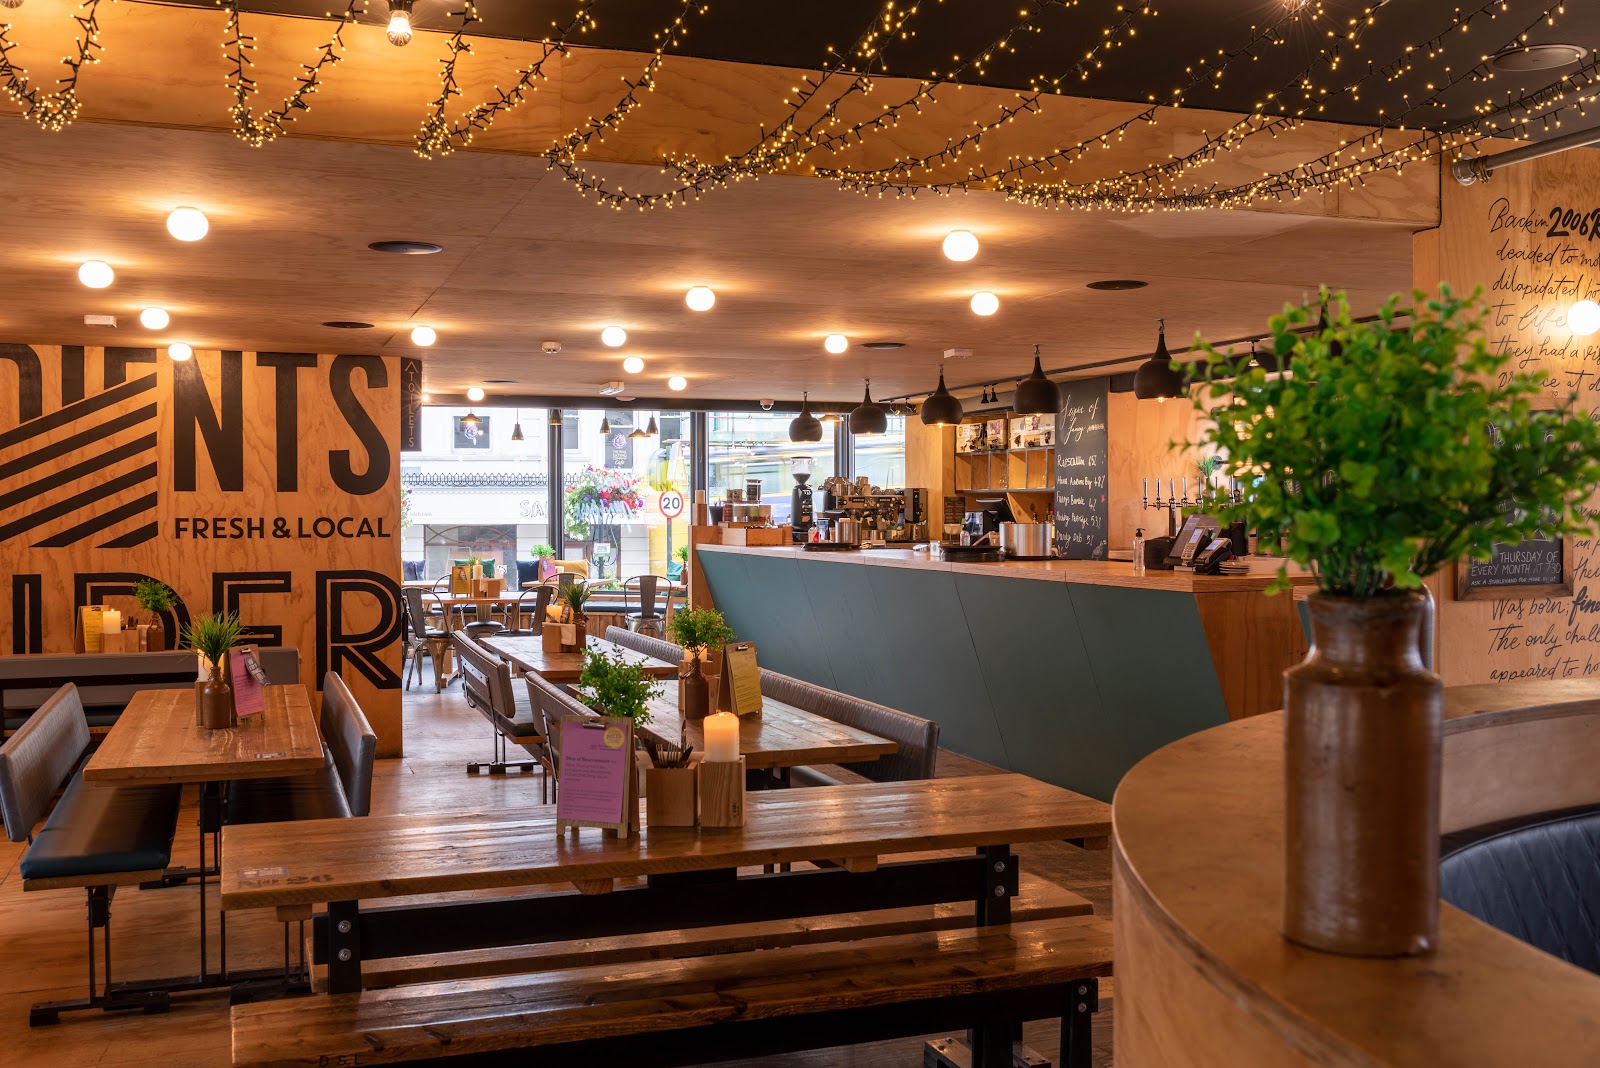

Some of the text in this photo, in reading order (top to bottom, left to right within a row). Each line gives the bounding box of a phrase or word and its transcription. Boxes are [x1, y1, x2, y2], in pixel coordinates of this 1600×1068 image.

[1546, 206, 1590, 238] 2006
[1588, 207, 1600, 242] R
[1560, 244, 1579, 265] to
[1580, 252, 1600, 267] mo
[1492, 269, 1584, 301] dilapidated
[1491, 299, 1567, 335] to life
[1490, 333, 1541, 369] they
[1538, 335, 1574, 360] had
[1569, 349, 1579, 358] a
[663, 497, 680, 510] 20
[175, 516, 391, 540] FRESH & LOCAL
[1500, 550, 1543, 563] THURSDAY
[1546, 550, 1559, 563] OF
[1471, 564, 1500, 577] EVERY
[1501, 563, 1531, 575] MONTH
[1492, 598, 1524, 620] Was
[1487, 623, 1523, 656] The
[1525, 623, 1563, 657] only
[1489, 656, 1562, 683] appeared
[1562, 656, 1580, 678] to
